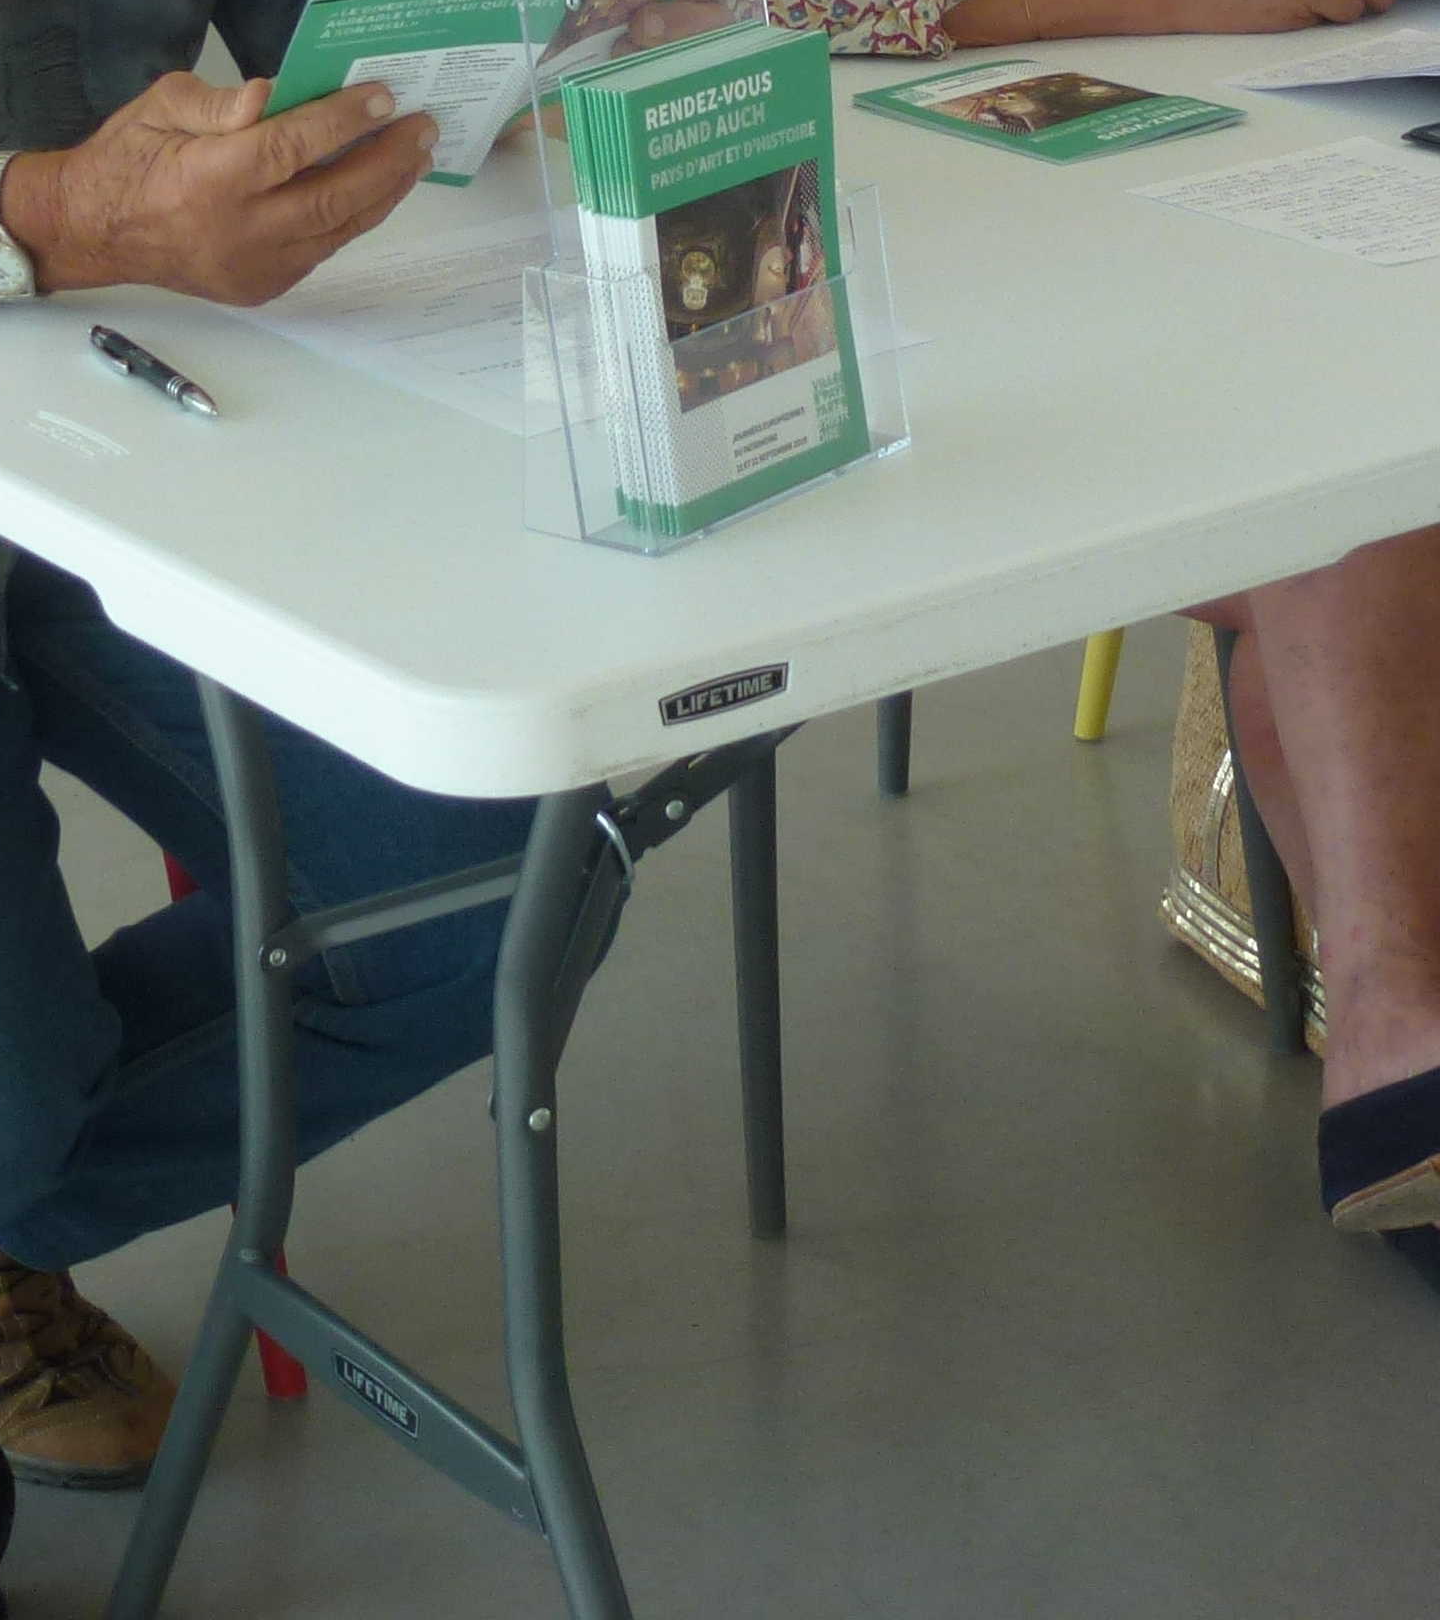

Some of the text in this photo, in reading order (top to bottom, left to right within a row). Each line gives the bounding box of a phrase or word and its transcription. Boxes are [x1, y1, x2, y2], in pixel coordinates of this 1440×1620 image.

[645, 70, 773, 131] RENDEZ-VOUS
[647, 101, 767, 161] GRAND AUCH
[650, 119, 817, 191] PAYS D'ART ET D'HISTOIRE
[675, 672, 774, 717] LIFETIME
[344, 1360, 409, 1426] LIFETIME
